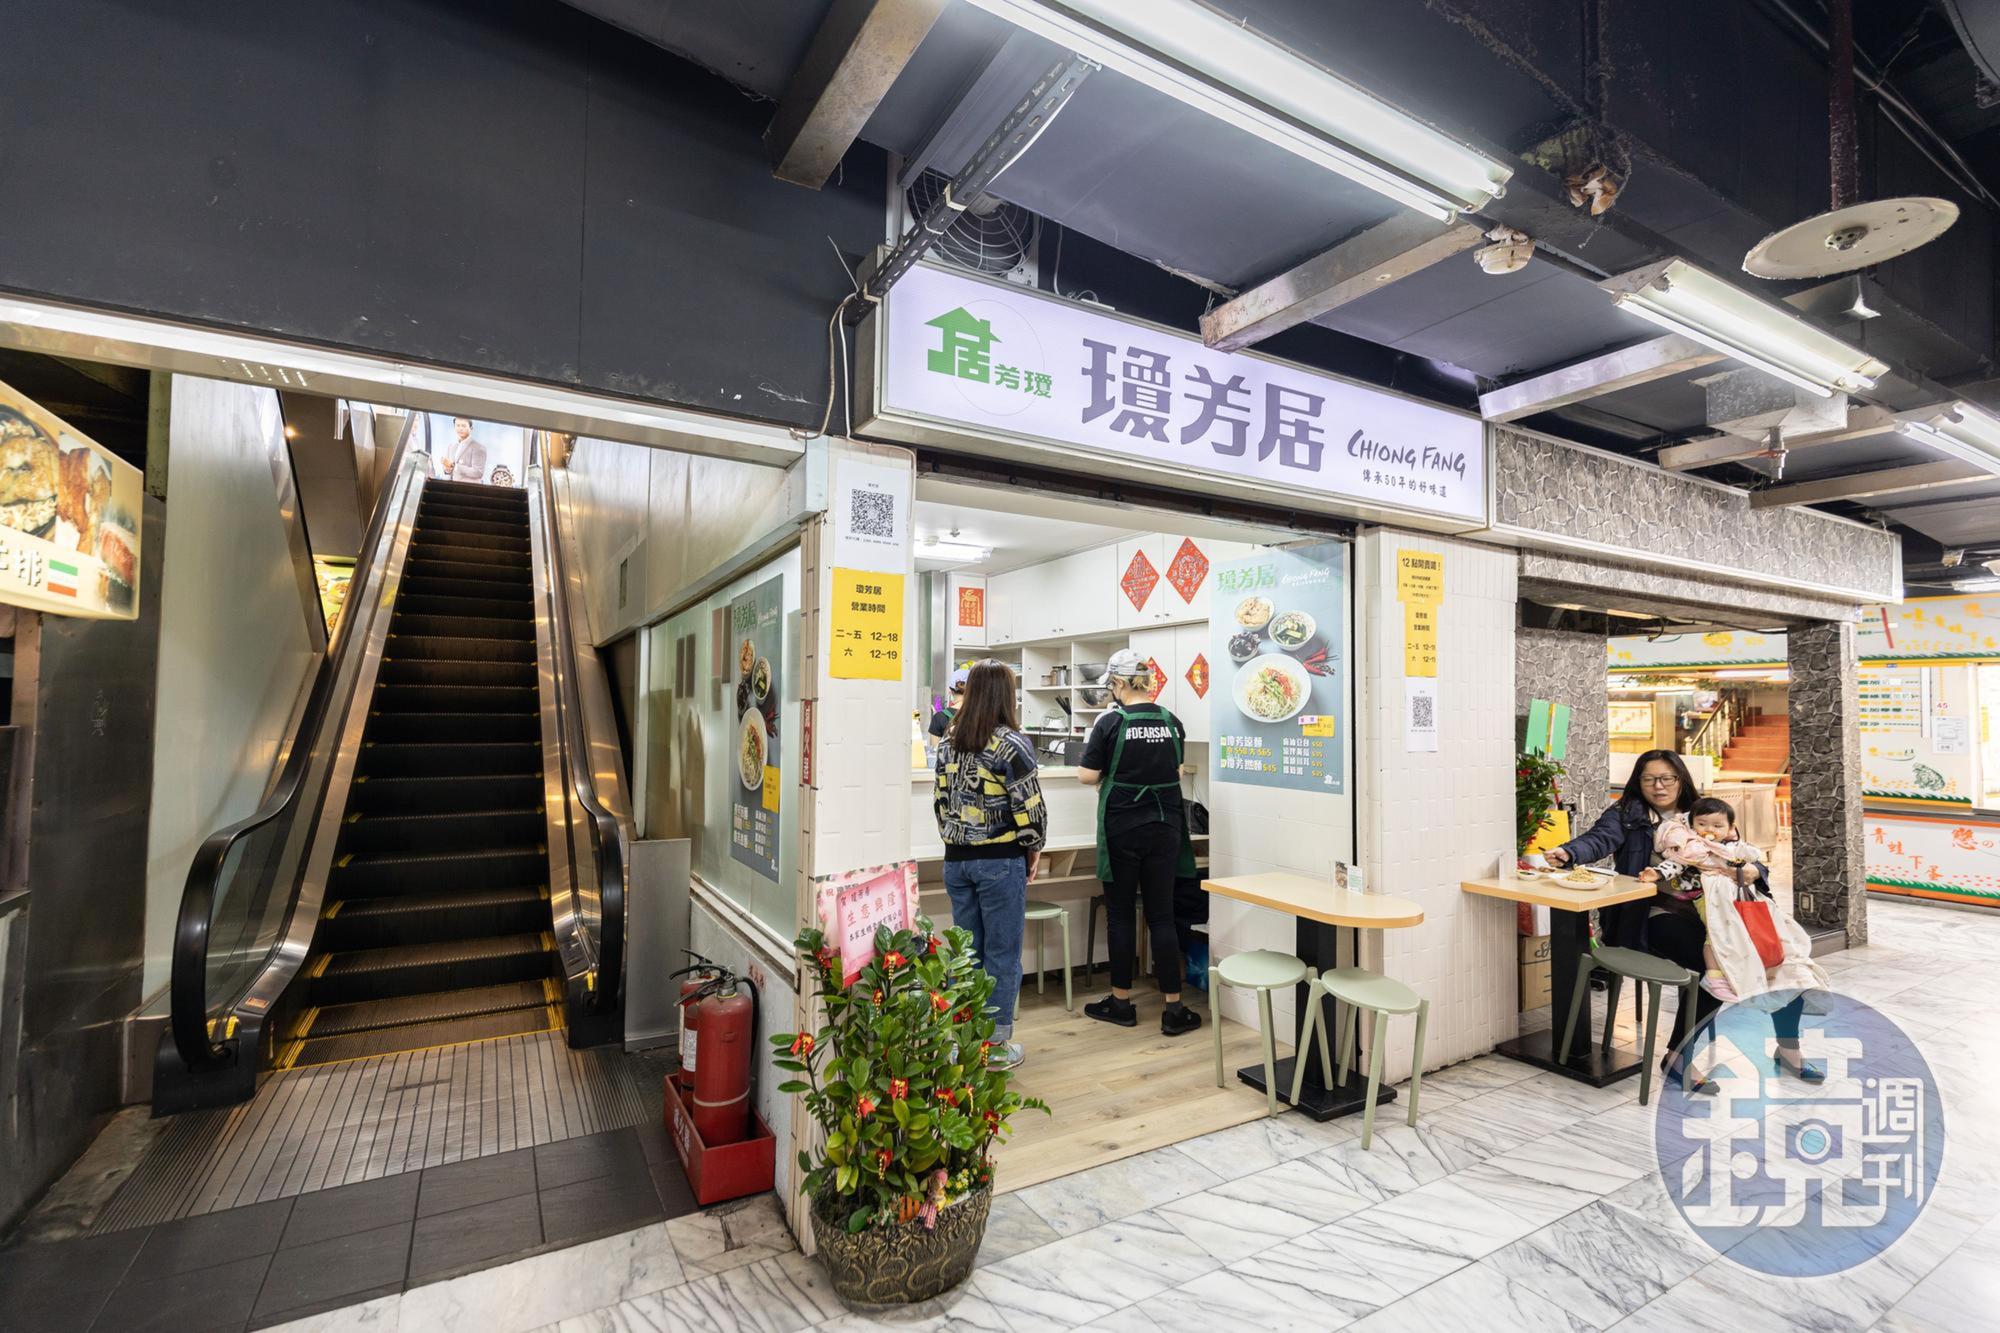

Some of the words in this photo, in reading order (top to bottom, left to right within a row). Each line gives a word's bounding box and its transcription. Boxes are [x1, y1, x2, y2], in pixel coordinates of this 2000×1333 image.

[1081, 338, 1325, 472] 瓊芳居
[1347, 429, 1416, 470] CHIONG
[1422, 446, 1466, 481] FANG
[1362, 469, 1447, 498] 傳承50年的好味道
[851, 601, 886, 613] 營業時間
[844, 647, 853, 656] 六
